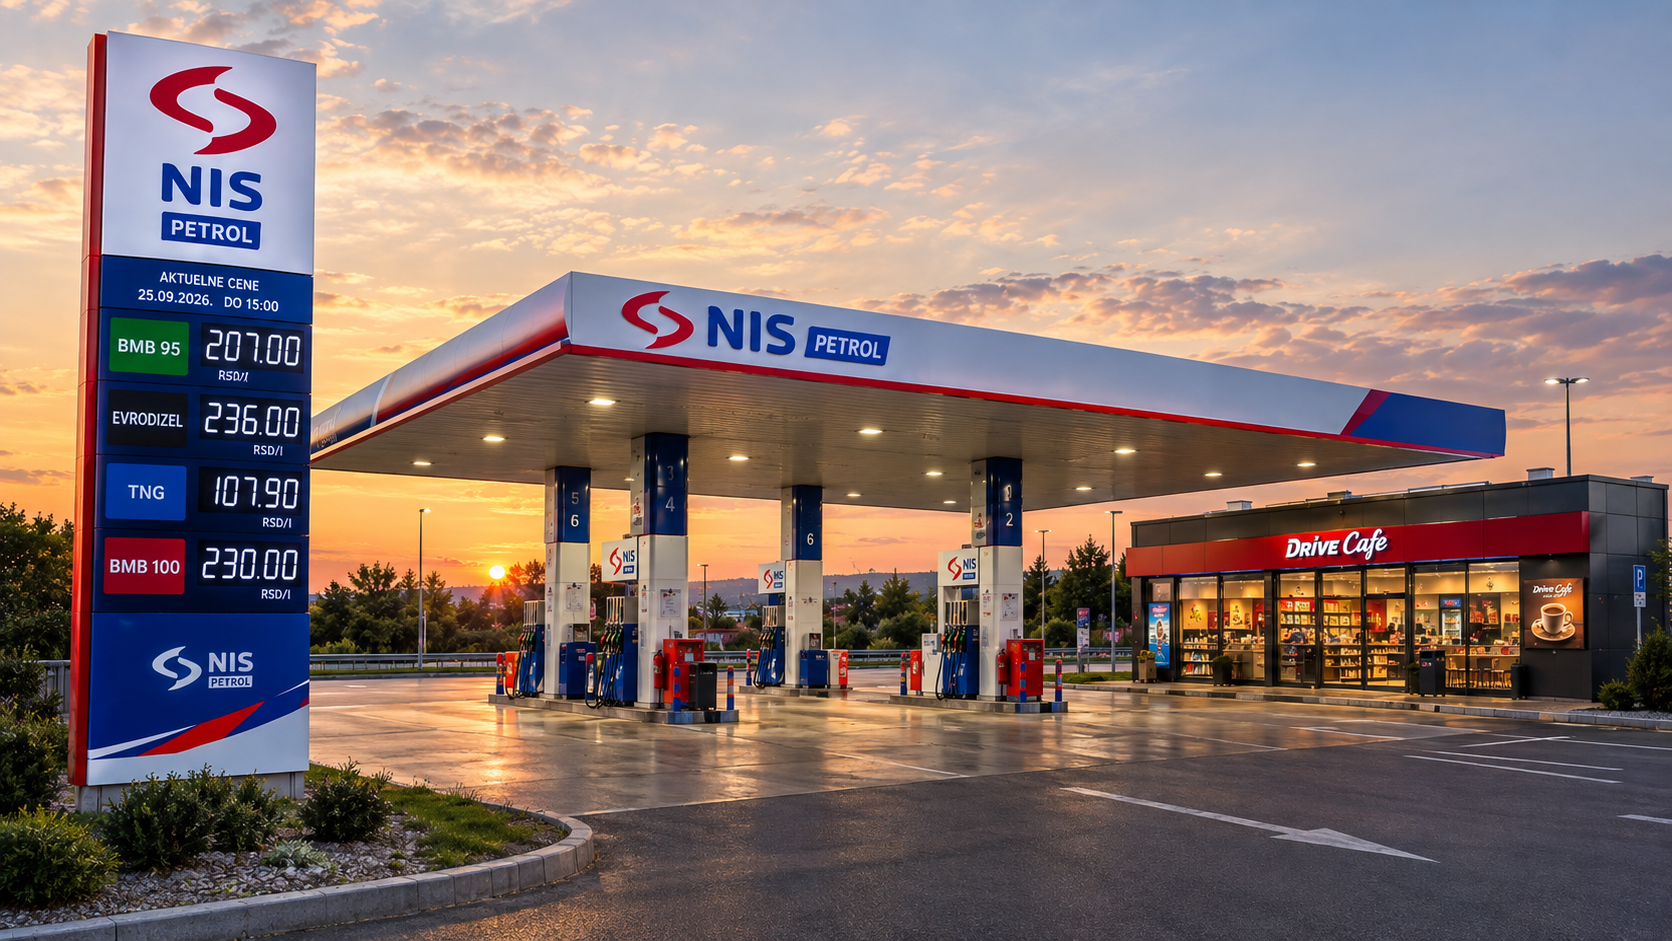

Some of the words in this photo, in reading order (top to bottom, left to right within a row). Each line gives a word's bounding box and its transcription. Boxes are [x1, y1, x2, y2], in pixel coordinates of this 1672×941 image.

[161, 162, 263, 212] NIS
[171, 219, 253, 244] PETROL
[159, 271, 224, 288] AKTUELNE
[228, 278, 260, 291] CENE
[138, 288, 213, 306] 25.09.2026.
[224, 296, 242, 309] DO
[246, 298, 279, 312] 15:00
[707, 305, 796, 356] NIS
[814, 334, 882, 360] PETROL
[117, 338, 156, 355] BMB
[160, 341, 181, 356] 95
[205, 329, 301, 367] 207.00
[112, 411, 184, 428] EVRODIZEL
[204, 402, 301, 438] 236.00
[127, 484, 165, 500] TNG
[214, 475, 300, 510] 107.90
[571, 491, 580, 505] 5
[665, 496, 676, 512] 4
[570, 514, 580, 528] 6
[1005, 512, 1014, 527] 2
[806, 532, 815, 546] 6
[1342, 528, 1388, 561] Cafe
[109, 558, 148, 574] BMB
[152, 560, 180, 575] 100
[202, 547, 299, 580] 230.00
[962, 558, 977, 571] NIS
[1637, 569, 1643, 588] P
[208, 652, 254, 673] NIS
[211, 676, 251, 687] PETROL
